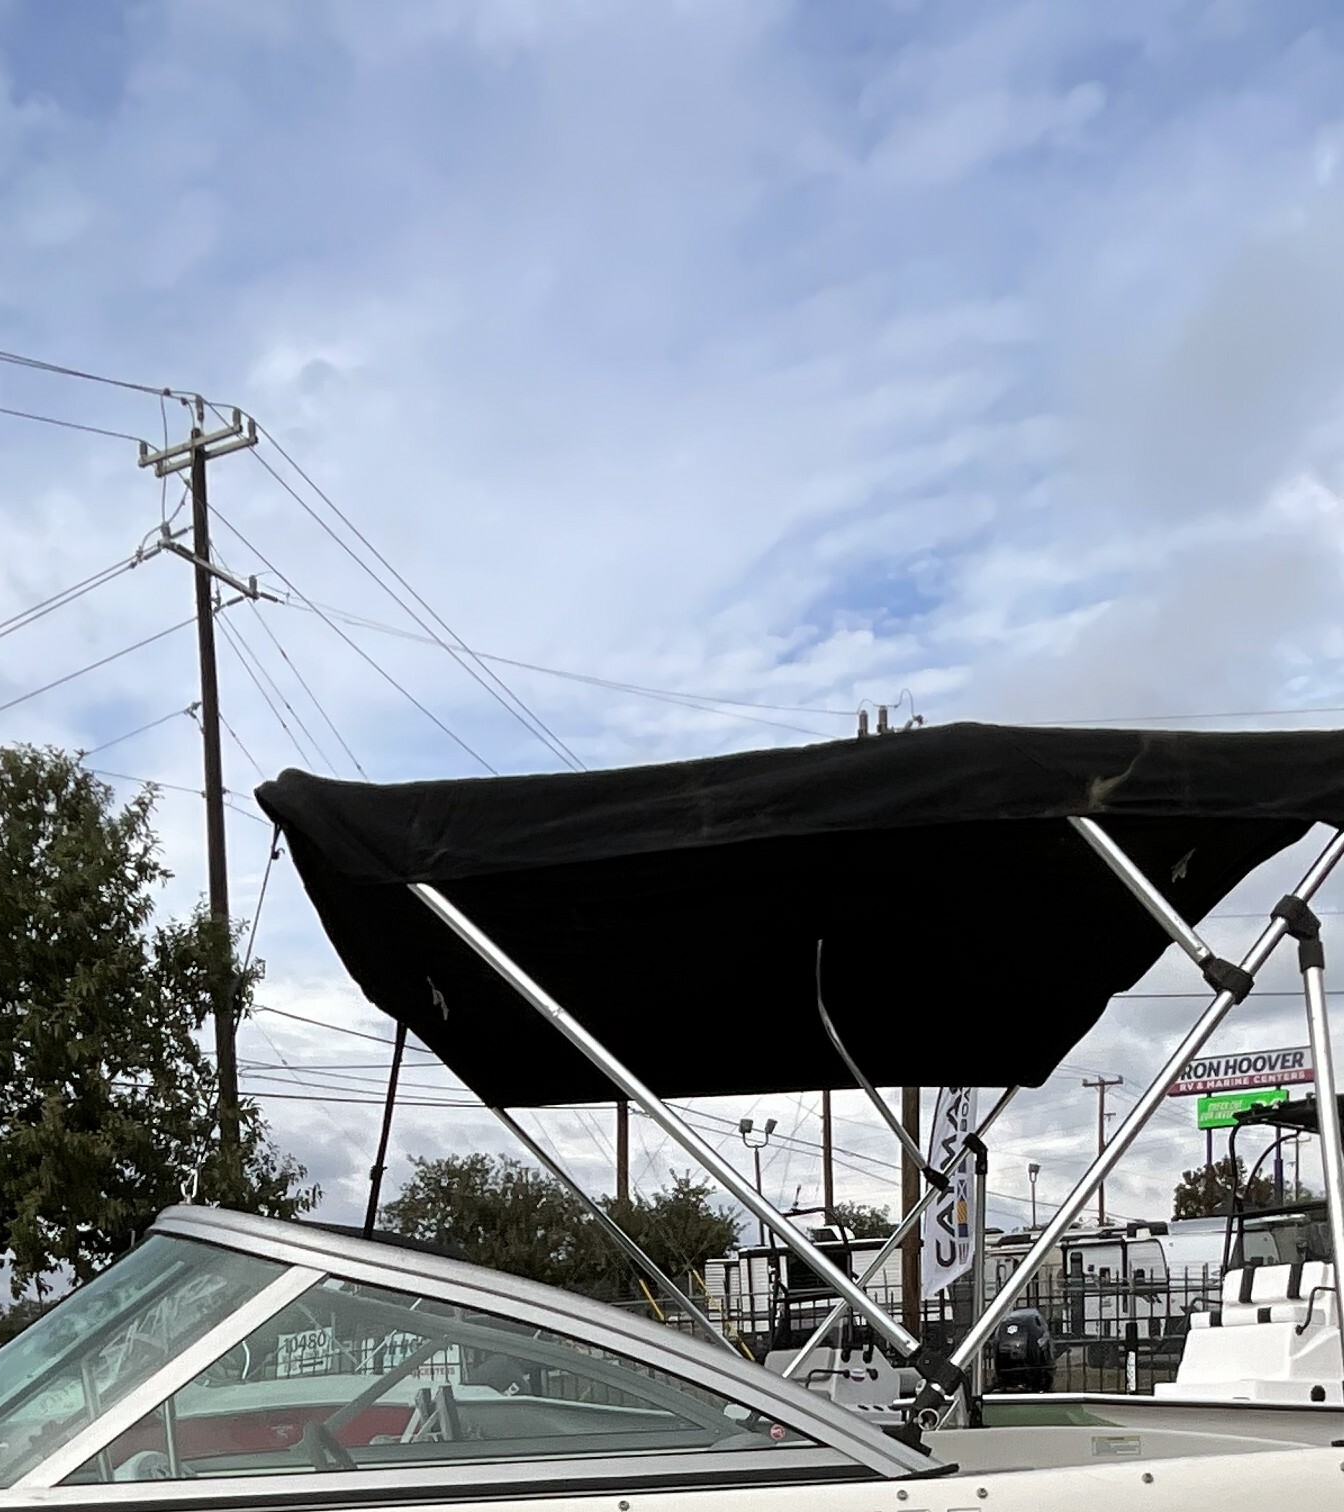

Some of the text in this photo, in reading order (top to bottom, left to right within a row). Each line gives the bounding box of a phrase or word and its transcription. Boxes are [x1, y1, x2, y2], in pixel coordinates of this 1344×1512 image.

[1180, 1051, 1305, 1080] RON HOOVER
[1179, 1083, 1193, 1091] RV
[1206, 1077, 1250, 1088] MARINE
[1253, 1070, 1306, 1083] CENTERS
[936, 1087, 962, 1268] CAYMA
